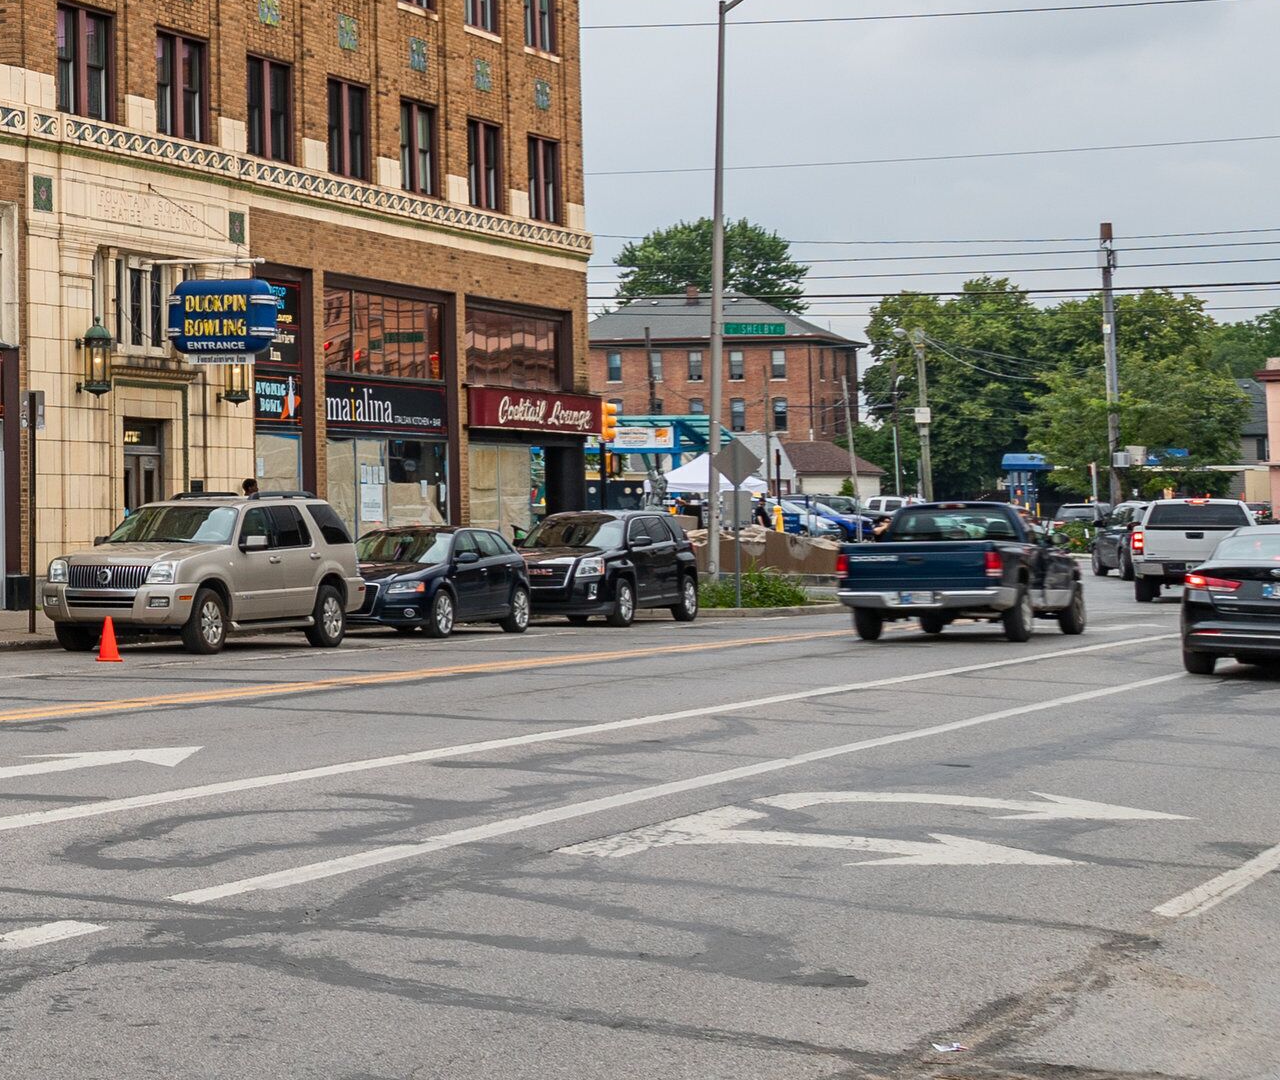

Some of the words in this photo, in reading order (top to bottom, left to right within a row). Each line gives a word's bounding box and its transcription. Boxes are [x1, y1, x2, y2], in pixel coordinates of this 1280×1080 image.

[100, 190, 150, 209] FOUNTAIN
[97, 204, 142, 223] THEATRE
[153, 213, 198, 232] BUILDING
[185, 294, 247, 312] DUCKPIN
[276, 313, 293, 324] ounge
[184, 319, 247, 337] BOWLING
[741, 323, 775, 334] SHELBY
[187, 341, 246, 350] ENTRANCE
[255, 381, 286, 396] ATOMIC
[260, 397, 283, 412] BOWL
[326, 387, 393, 423] maialina
[498, 395, 548, 424] Cocktail
[548, 400, 593, 430] Lounge
